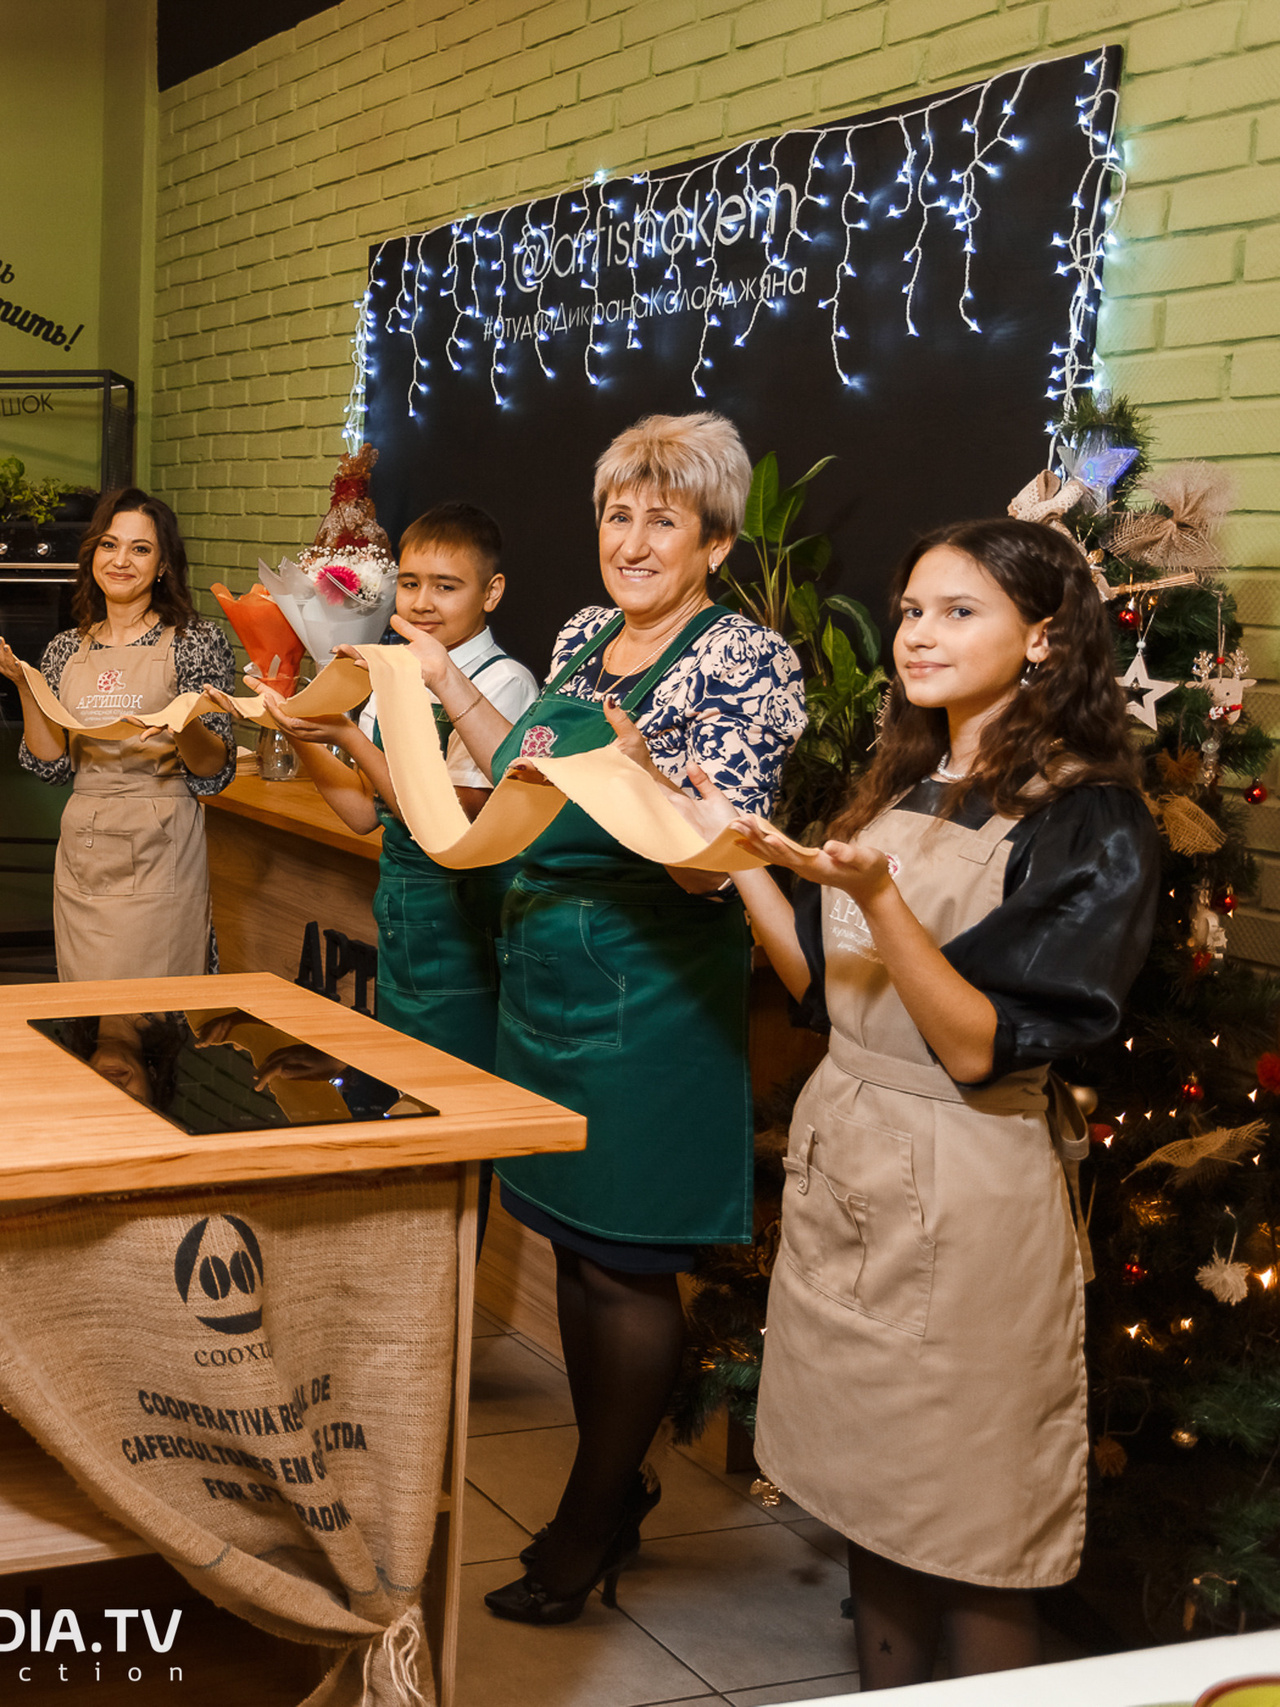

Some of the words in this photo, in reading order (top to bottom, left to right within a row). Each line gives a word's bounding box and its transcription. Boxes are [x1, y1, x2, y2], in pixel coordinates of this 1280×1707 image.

[75, 694, 144, 710] АРТИШОК
[138, 1390, 279, 1436] COOPERATIVA
[311, 1374, 331, 1406] DE
[279, 1456, 314, 1484] EM
[322, 1421, 367, 1452] LTDA
[202, 1478, 248, 1500] FOR
